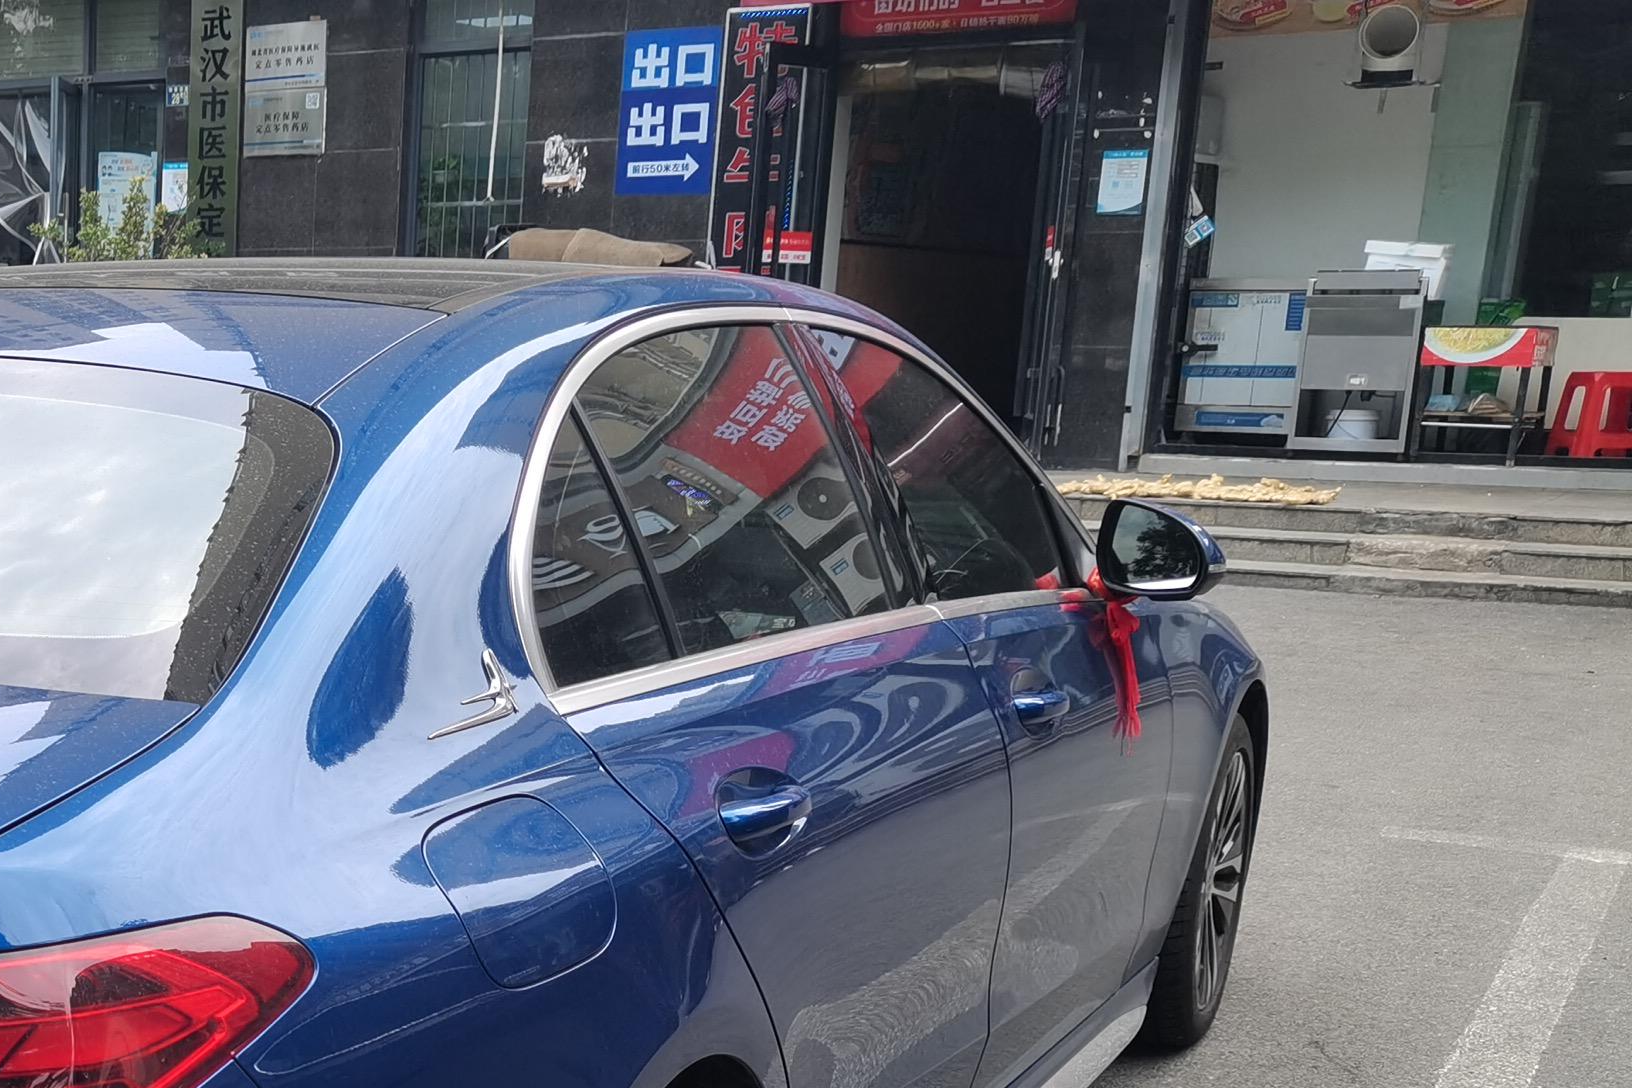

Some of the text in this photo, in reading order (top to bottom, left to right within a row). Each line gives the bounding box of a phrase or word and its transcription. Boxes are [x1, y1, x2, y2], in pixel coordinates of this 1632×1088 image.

[631, 43, 715, 88] 出口
[196, 6, 232, 238] 武汉市医保定
[264, 111, 300, 123] 医疗保障
[626, 102, 710, 147] 出口
[632, 162, 690, 175] 前行50米左转
